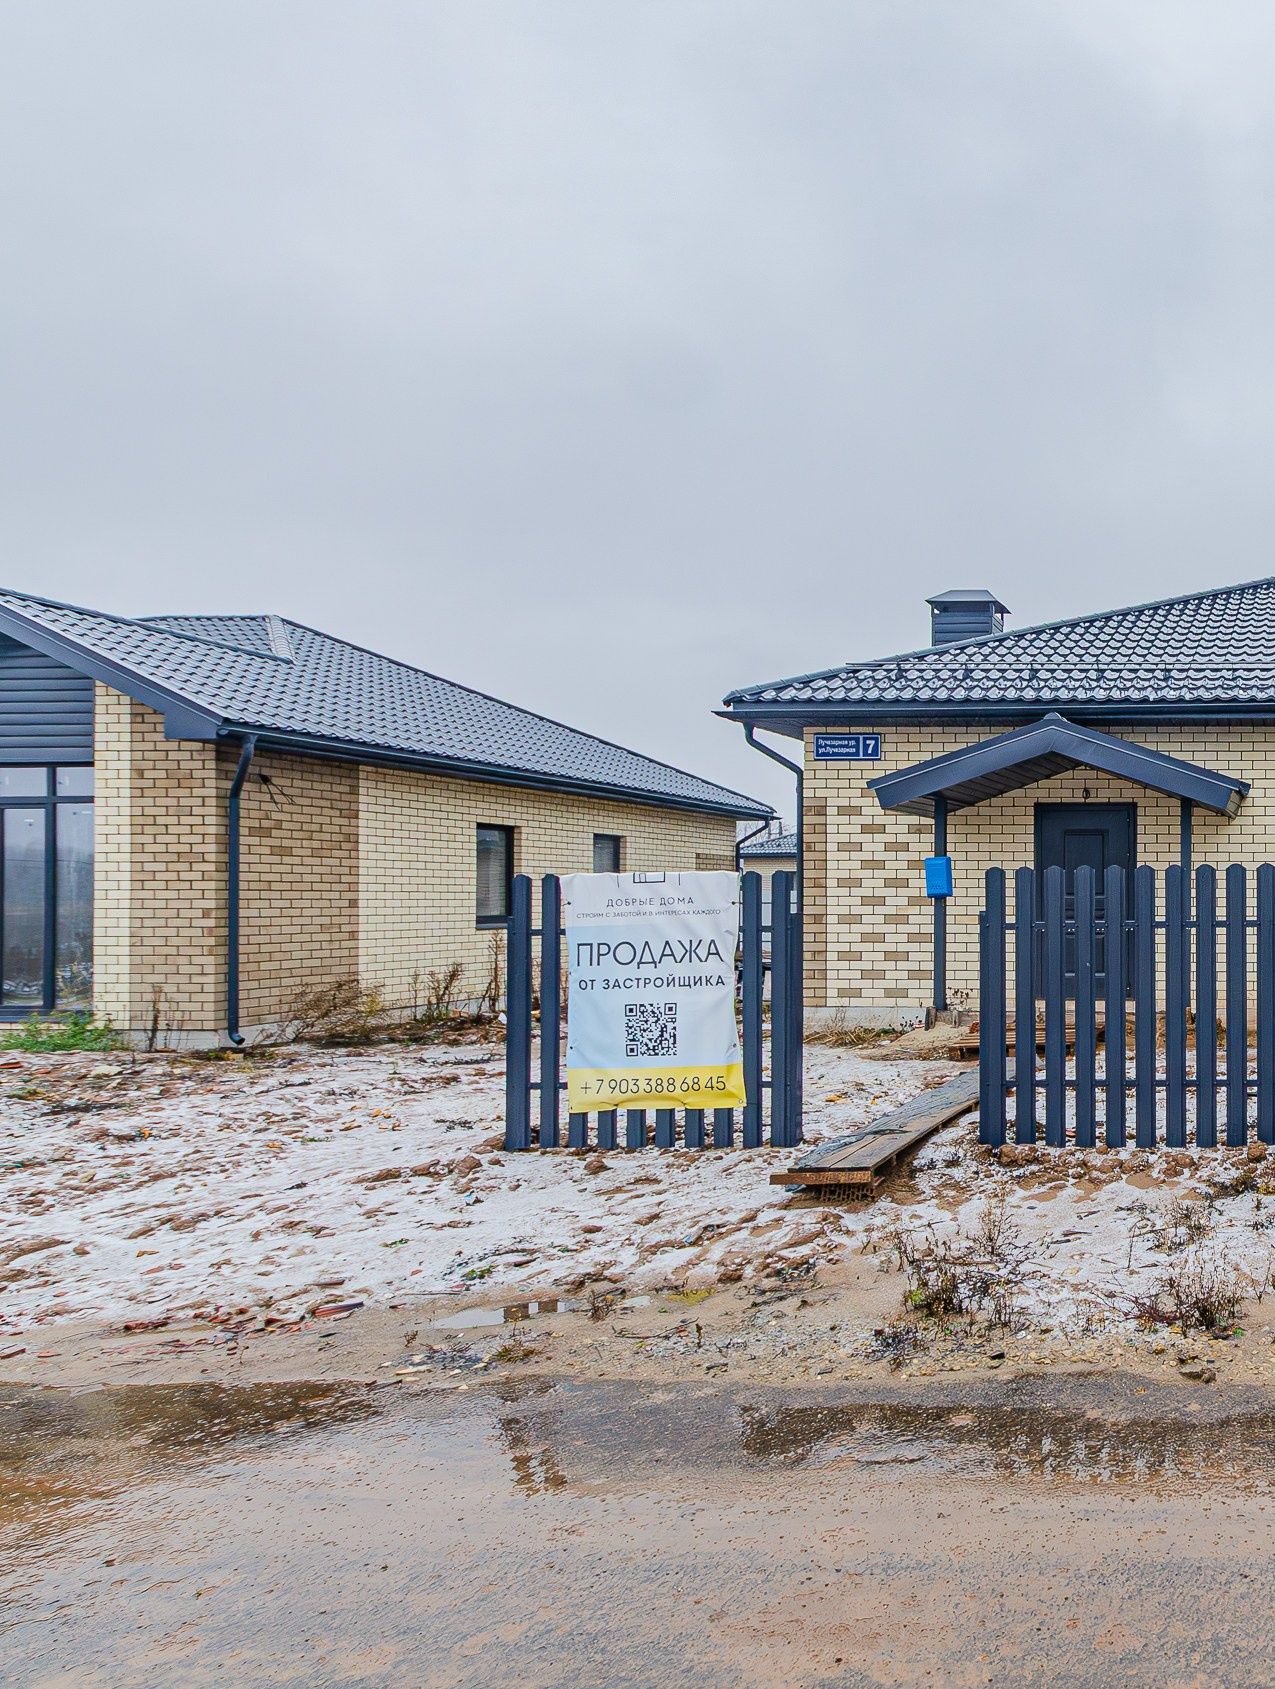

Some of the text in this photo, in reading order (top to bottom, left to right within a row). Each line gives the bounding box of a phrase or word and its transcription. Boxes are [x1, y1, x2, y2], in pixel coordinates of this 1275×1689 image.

[866, 740, 875, 753] 7
[606, 896, 694, 908] ДОБРЫЕ ДОМА
[612, 910, 642, 918] ЗАБОТОЙ
[577, 939, 724, 969] ПРОДАЖА
[578, 974, 726, 990] ОТ ЗАСТРОЙЩИКА
